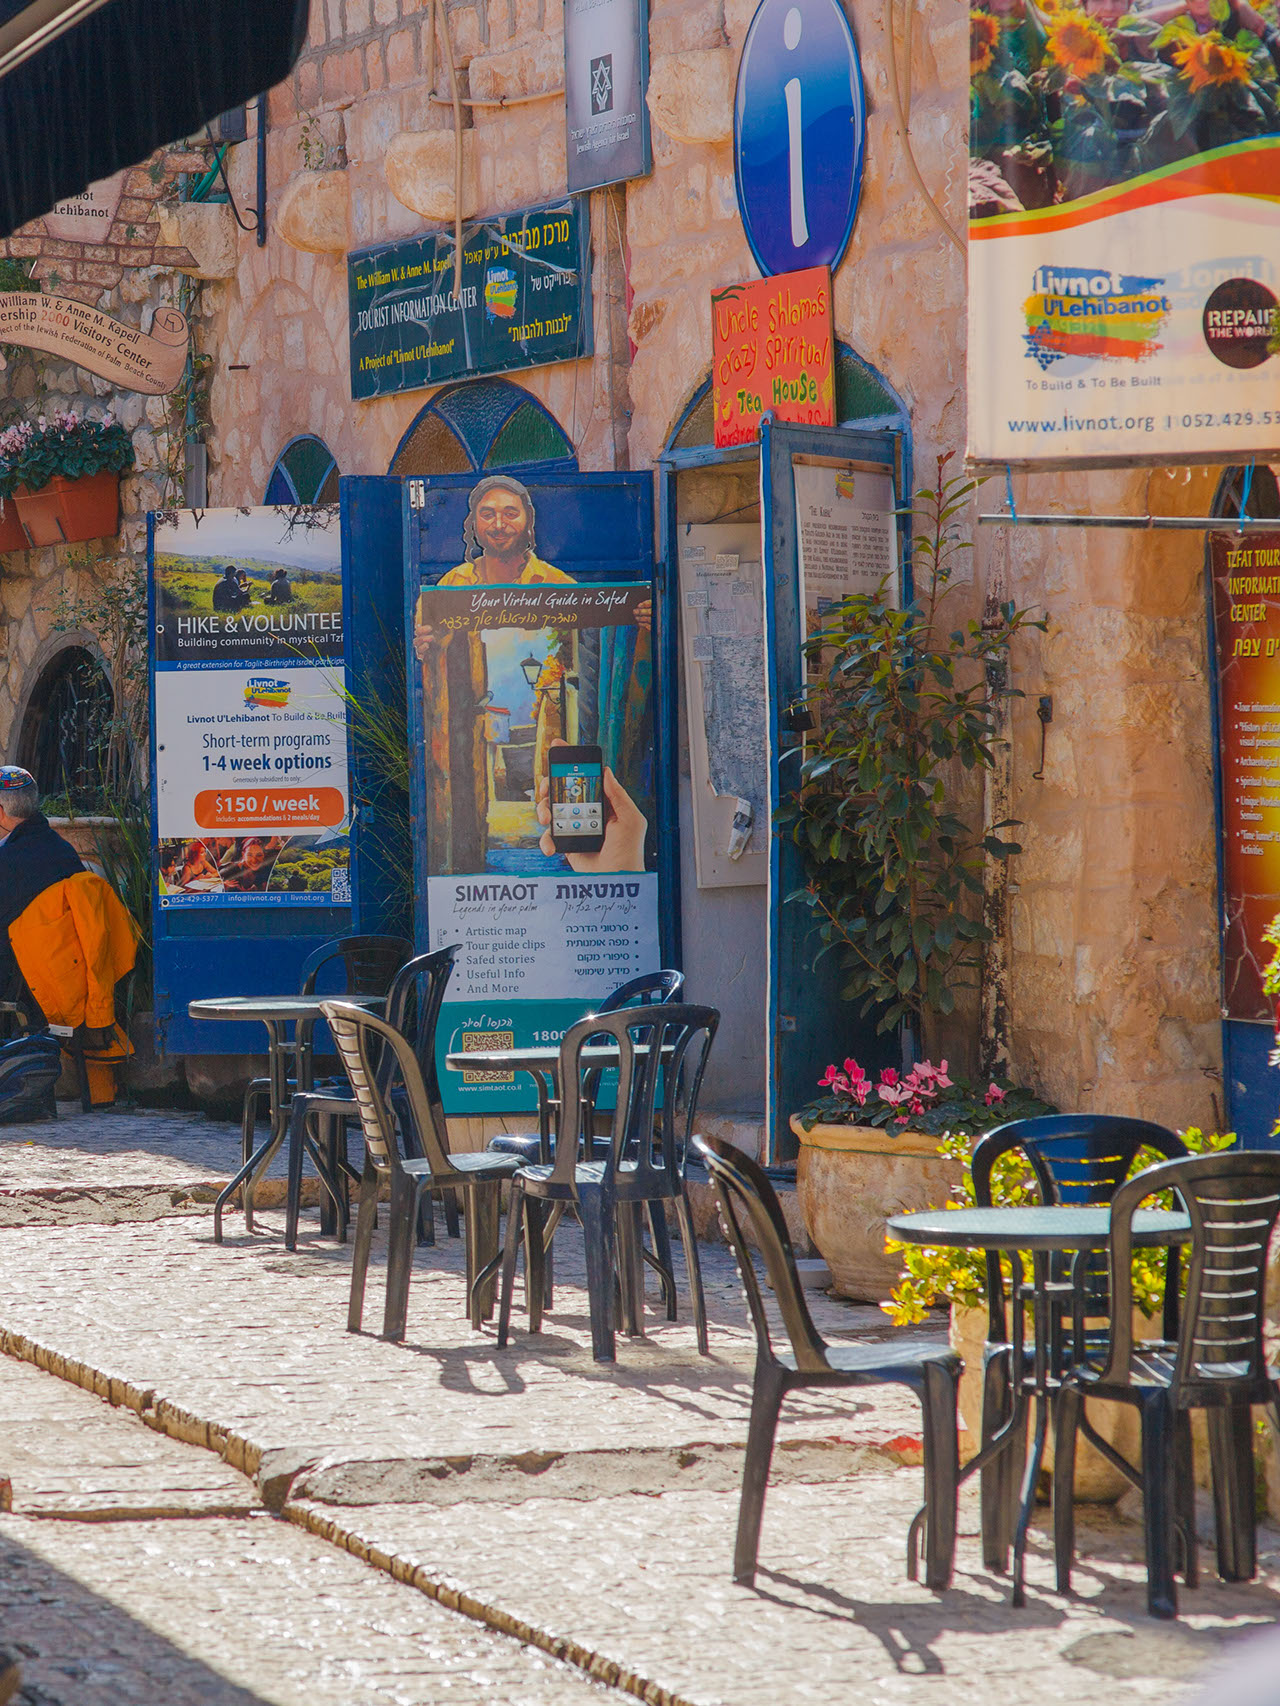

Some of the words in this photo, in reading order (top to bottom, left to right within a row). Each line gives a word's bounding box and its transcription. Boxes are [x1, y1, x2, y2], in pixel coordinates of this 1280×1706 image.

[54, 203, 109, 218] Lehibanot
[543, 219, 569, 247] מרכז
[464, 249, 483, 265] קאפל
[356, 276, 368, 290] The
[368, 270, 391, 288] William
[391, 268, 400, 282] W.
[400, 266, 406, 280] &
[406, 264, 422, 279] Anne
[423, 260, 432, 275] M.
[487, 268, 509, 283] Livnot
[1035, 268, 1124, 297] Livnot
[530, 275, 542, 292] של
[357, 305, 390, 332] TOURIST
[391, 292, 446, 325] INFORMATION
[447, 286, 478, 312] CENTER
[0, 295, 37, 309] William
[41, 297, 52, 309] W.
[55, 300, 63, 311] &
[65, 304, 91, 321] Anne
[92, 314, 105, 328] M.
[108, 321, 140, 345] Kapell
[718, 300, 759, 342] Uncle
[41, 309, 70, 328] 2000
[73, 319, 115, 347] Visitors'
[116, 343, 152, 369] Center
[1208, 327, 1233, 338] THE
[15, 323, 22, 332] of
[23, 323, 35, 332] the
[36, 324, 59, 339] Jewish
[60, 332, 97, 357] Federation
[97, 350, 105, 359] of
[105, 353, 122, 368] Palm
[124, 362, 145, 378] Beach
[145, 373, 167, 391] County
[359, 357, 365, 371] A
[365, 353, 386, 370] Project
[386, 350, 393, 365] of
[1026, 380, 1039, 390] To
[1041, 379, 1073, 391] Build
[1078, 379, 1086, 389] &
[1091, 378, 1106, 388] To
[1111, 377, 1126, 388] Be
[1131, 376, 1162, 387] Built
[737, 388, 763, 418] Tea
[1008, 415, 1155, 433] www.livnot.org
[1182, 412, 1280, 428] 052.429.53
[1226, 550, 1253, 568] TZFAT
[470, 592, 500, 612] Your
[502, 591, 541, 607] Virtual
[544, 592, 578, 609] Guide
[580, 593, 592, 606] in
[594, 591, 629, 612] Safed
[1230, 603, 1267, 622] CENTER
[177, 616, 220, 634] HIKE
[224, 615, 239, 633] &
[241, 612, 342, 633] VOLUNTEE
[177, 637, 218, 649] Building
[220, 634, 275, 647] community
[277, 635, 286, 644] in
[288, 633, 329, 646] mystical
[1232, 638, 1262, 657] צפת
[183, 662, 201, 671] great
[201, 661, 233, 669] extension
[233, 660, 244, 668] for
[244, 659, 296, 669] Taglit-Birthright
[296, 658, 314, 666] Israel
[248, 679, 278, 688] Livnot
[187, 715, 215, 724] Livnot
[216, 713, 270, 723] U'Lehibanot
[271, 713, 283, 722] To
[284, 712, 305, 721] Build
[306, 712, 313, 721] &
[327, 711, 346, 720] Built
[202, 733, 270, 749] Short-term
[273, 733, 331, 751] programs
[202, 755, 227, 772] 1-4
[230, 753, 272, 771] week
[274, 752, 332, 774] options
[232, 776, 259, 784] Generously
[259, 775, 283, 783] subsidized
[215, 795, 258, 814] $150
[261, 795, 269, 812] /
[272, 794, 320, 811] week
[237, 814, 282, 822] accommodations
[291, 813, 320, 822] meals/day
[171, 895, 219, 903] 052-429-5377
[227, 894, 282, 903] info@livnot.org
[290, 894, 325, 903] livnot.org
[455, 883, 539, 902] SIMTAOT
[556, 883, 640, 900] סמטאות
[453, 903, 486, 920] Legends
[493, 904, 517, 920] your
[518, 902, 538, 914] palm
[465, 926, 503, 936] Artistic
[507, 927, 527, 938] map
[566, 924, 598, 933] הדרכה
[600, 924, 629, 932] סרטוני
[465, 941, 490, 951] Tour
[492, 940, 520, 952] guide
[522, 940, 546, 952] clips
[566, 939, 606, 948] אומנותית
[608, 938, 630, 947] מפה
[466, 955, 495, 965] Safed
[498, 955, 536, 964] stories
[577, 953, 601, 963] מקום
[602, 953, 630, 961] סיפורי
[466, 969, 500, 979] Useful
[504, 969, 526, 979] Info
[574, 967, 605, 976] שימושי
[607, 967, 630, 976] מידע
[466, 984, 489, 994] And
[492, 983, 520, 993] More
[458, 1084, 522, 1092] www.simtaot.co.il
